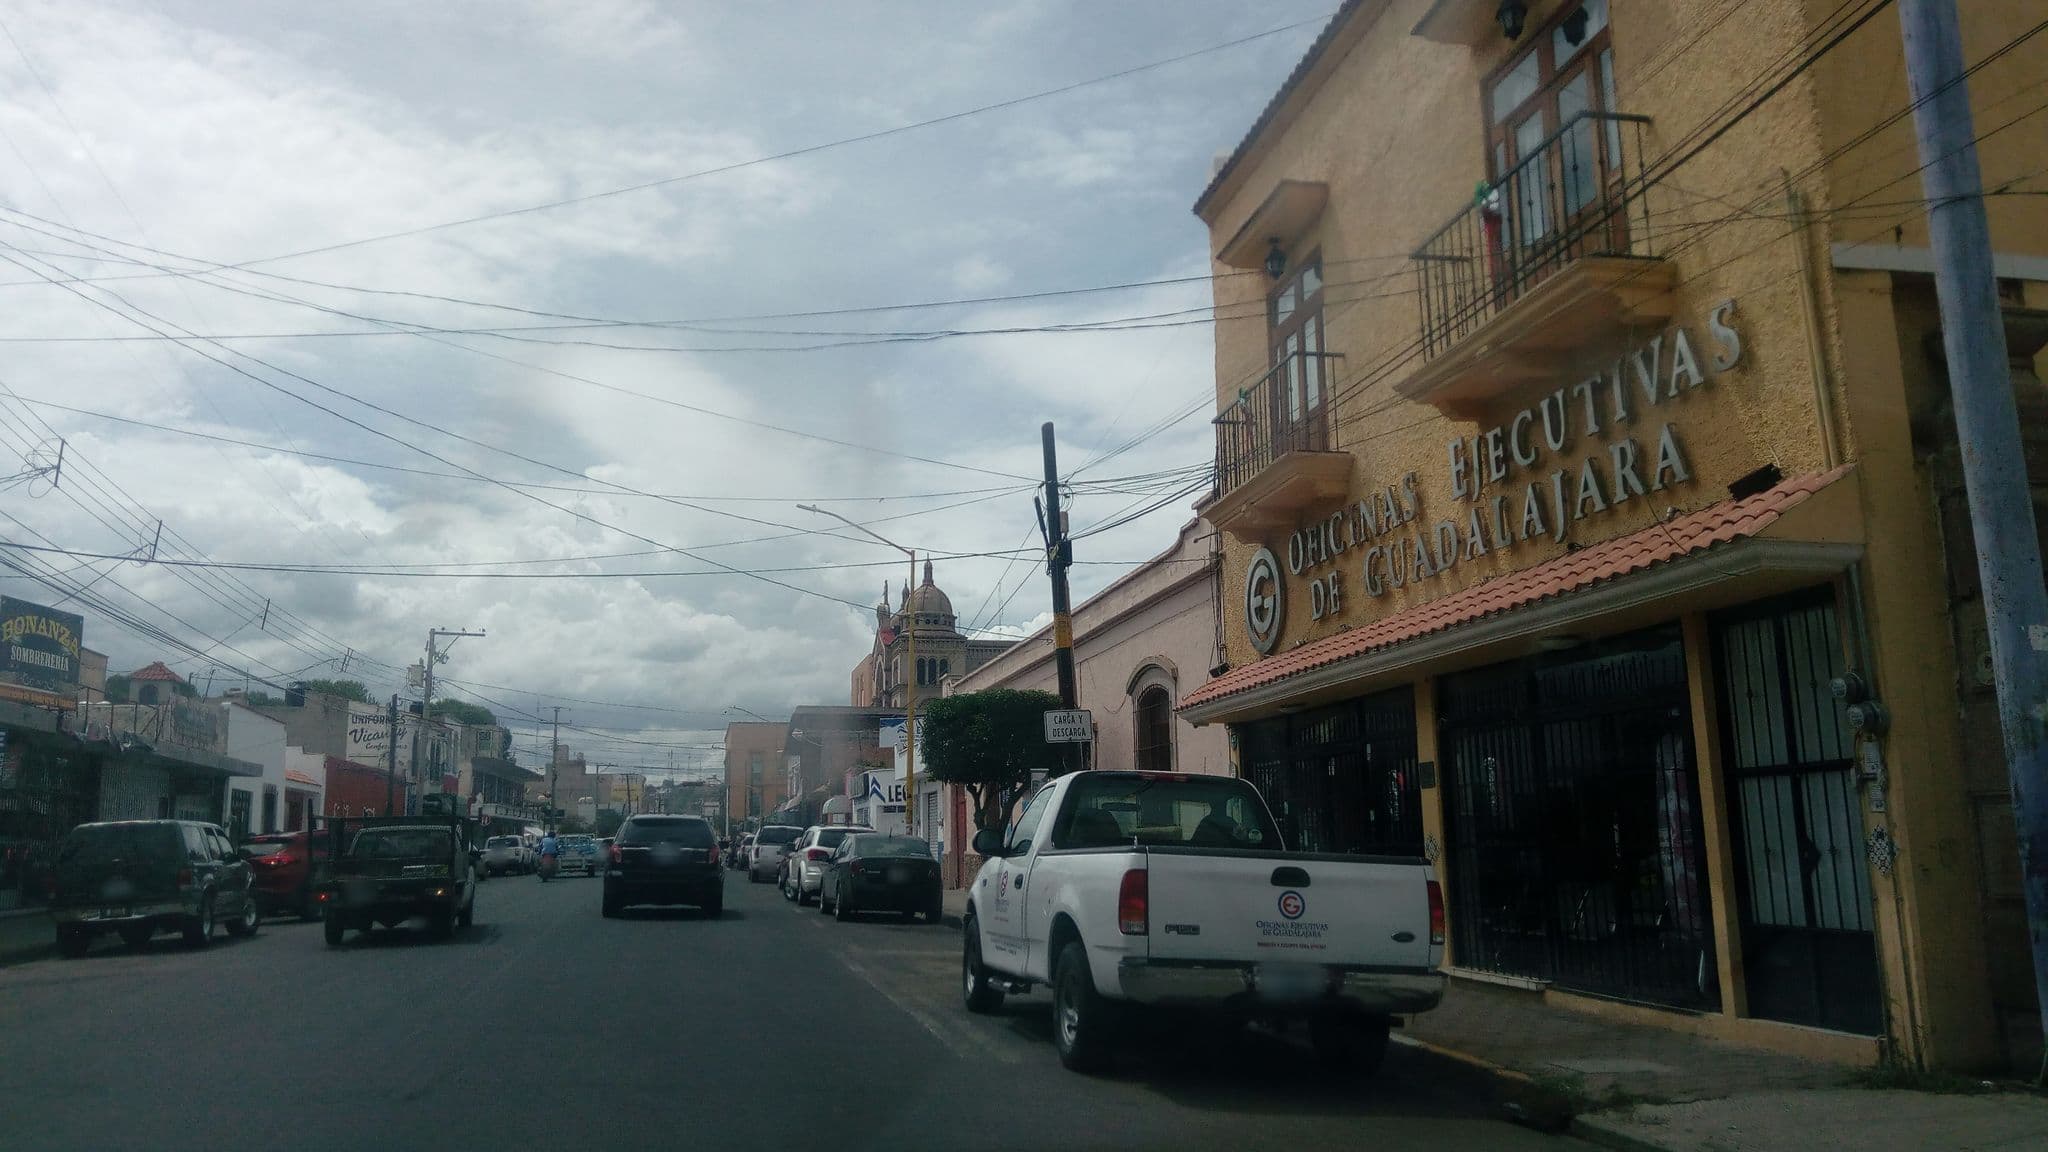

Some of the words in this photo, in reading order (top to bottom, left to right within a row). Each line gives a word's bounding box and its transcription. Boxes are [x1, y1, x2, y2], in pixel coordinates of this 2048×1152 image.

[1287, 471, 1419, 577] OFICINAS
[1448, 298, 1741, 502] EJECUTIVAS
[1310, 569, 1342, 622] DE
[1363, 422, 1690, 599] GUADALAJARA
[2, 615, 80, 659] BONANZA
[1053, 727, 1087, 737] DESCARGA
[1054, 715, 1075, 725] CARGA
[1078, 714, 1083, 724] Y
